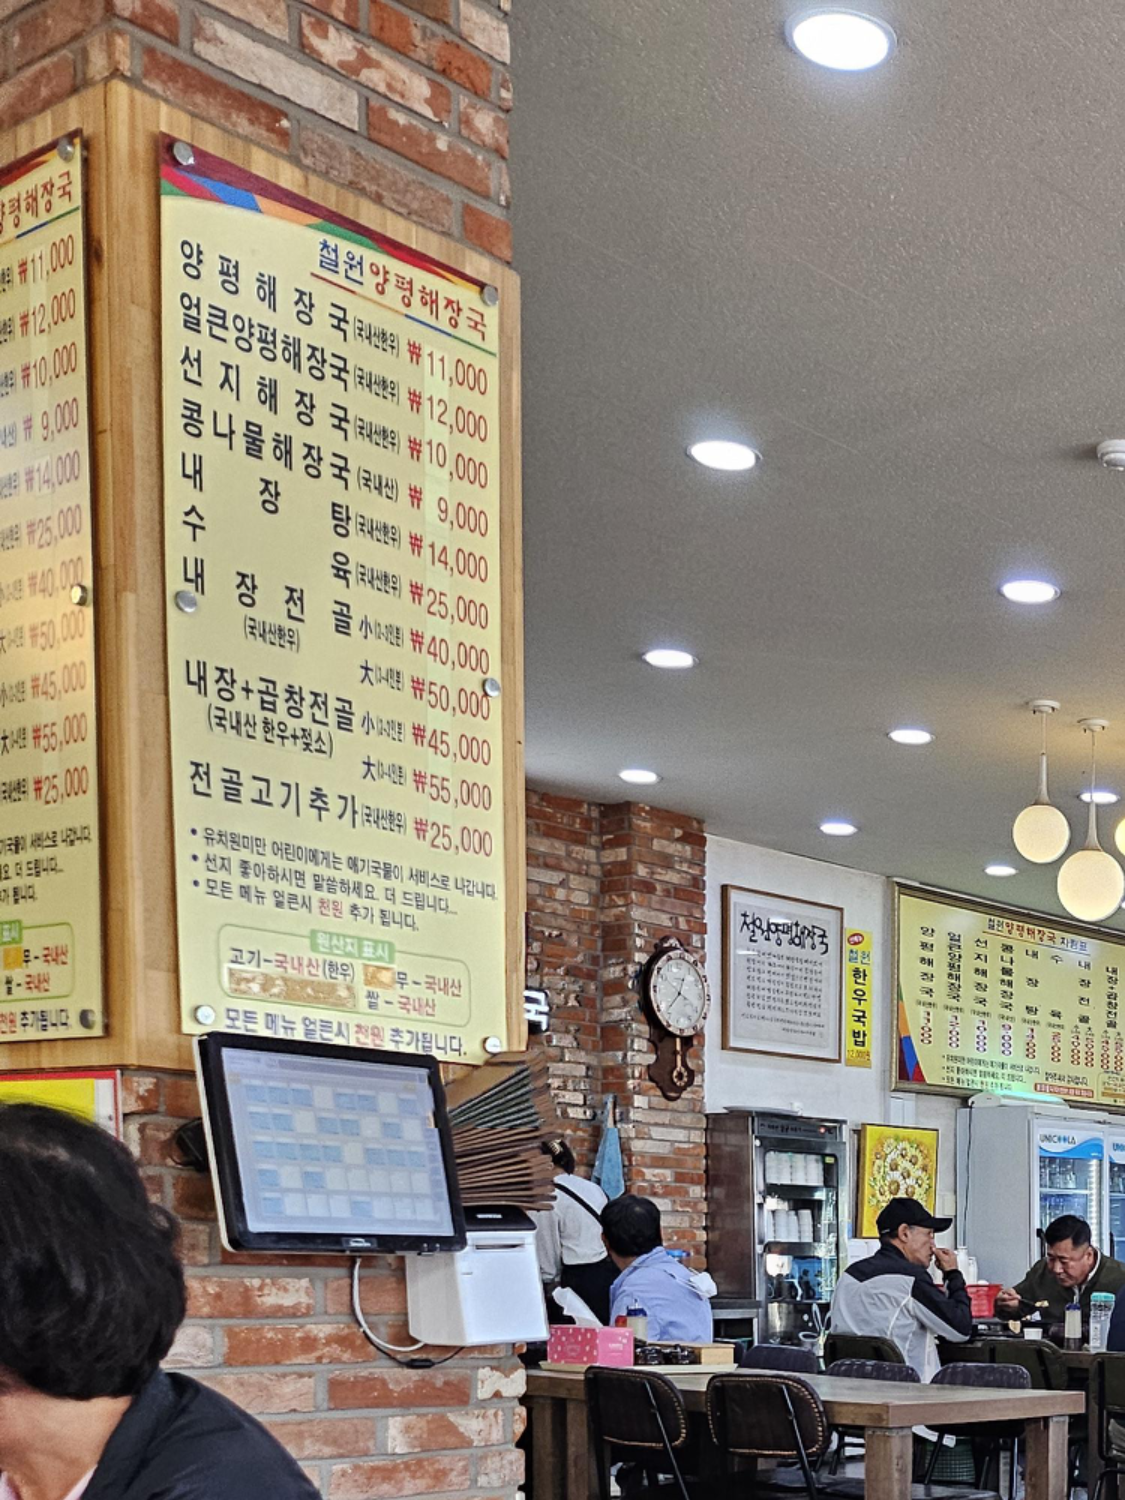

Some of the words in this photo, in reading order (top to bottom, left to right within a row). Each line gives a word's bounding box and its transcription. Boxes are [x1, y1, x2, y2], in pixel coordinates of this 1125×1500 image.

[180, 292, 350, 393] 얼큰양평해장국
[181, 397, 351, 491] 콩나물해장국
[357, 466, 399, 503] (국내산)
[185, 659, 355, 733] 내장+곱창전골
[203, 827, 266, 857] 유치원미만
[272, 840, 343, 871] 어린이에게는
[409, 866, 451, 891] 서비스로
[205, 853, 232, 876] 선지
[239, 859, 306, 889] 좋아하시면
[385, 886, 396, 905] 더
[205, 878, 234, 900] 모든
[240, 884, 267, 906] 메뉴
[273, 889, 312, 914] 얼큰시
[318, 897, 343, 919] 천원
[350, 902, 374, 925] 추가
[397, 994, 436, 1018] 국내산
[425, 974, 462, 998] 국내산
[852, 967, 868, 1048] 한우국밥
[225, 1007, 259, 1034] 모든
[264, 1012, 297, 1038] 메뉴
[354, 1022, 386, 1048] 천원
